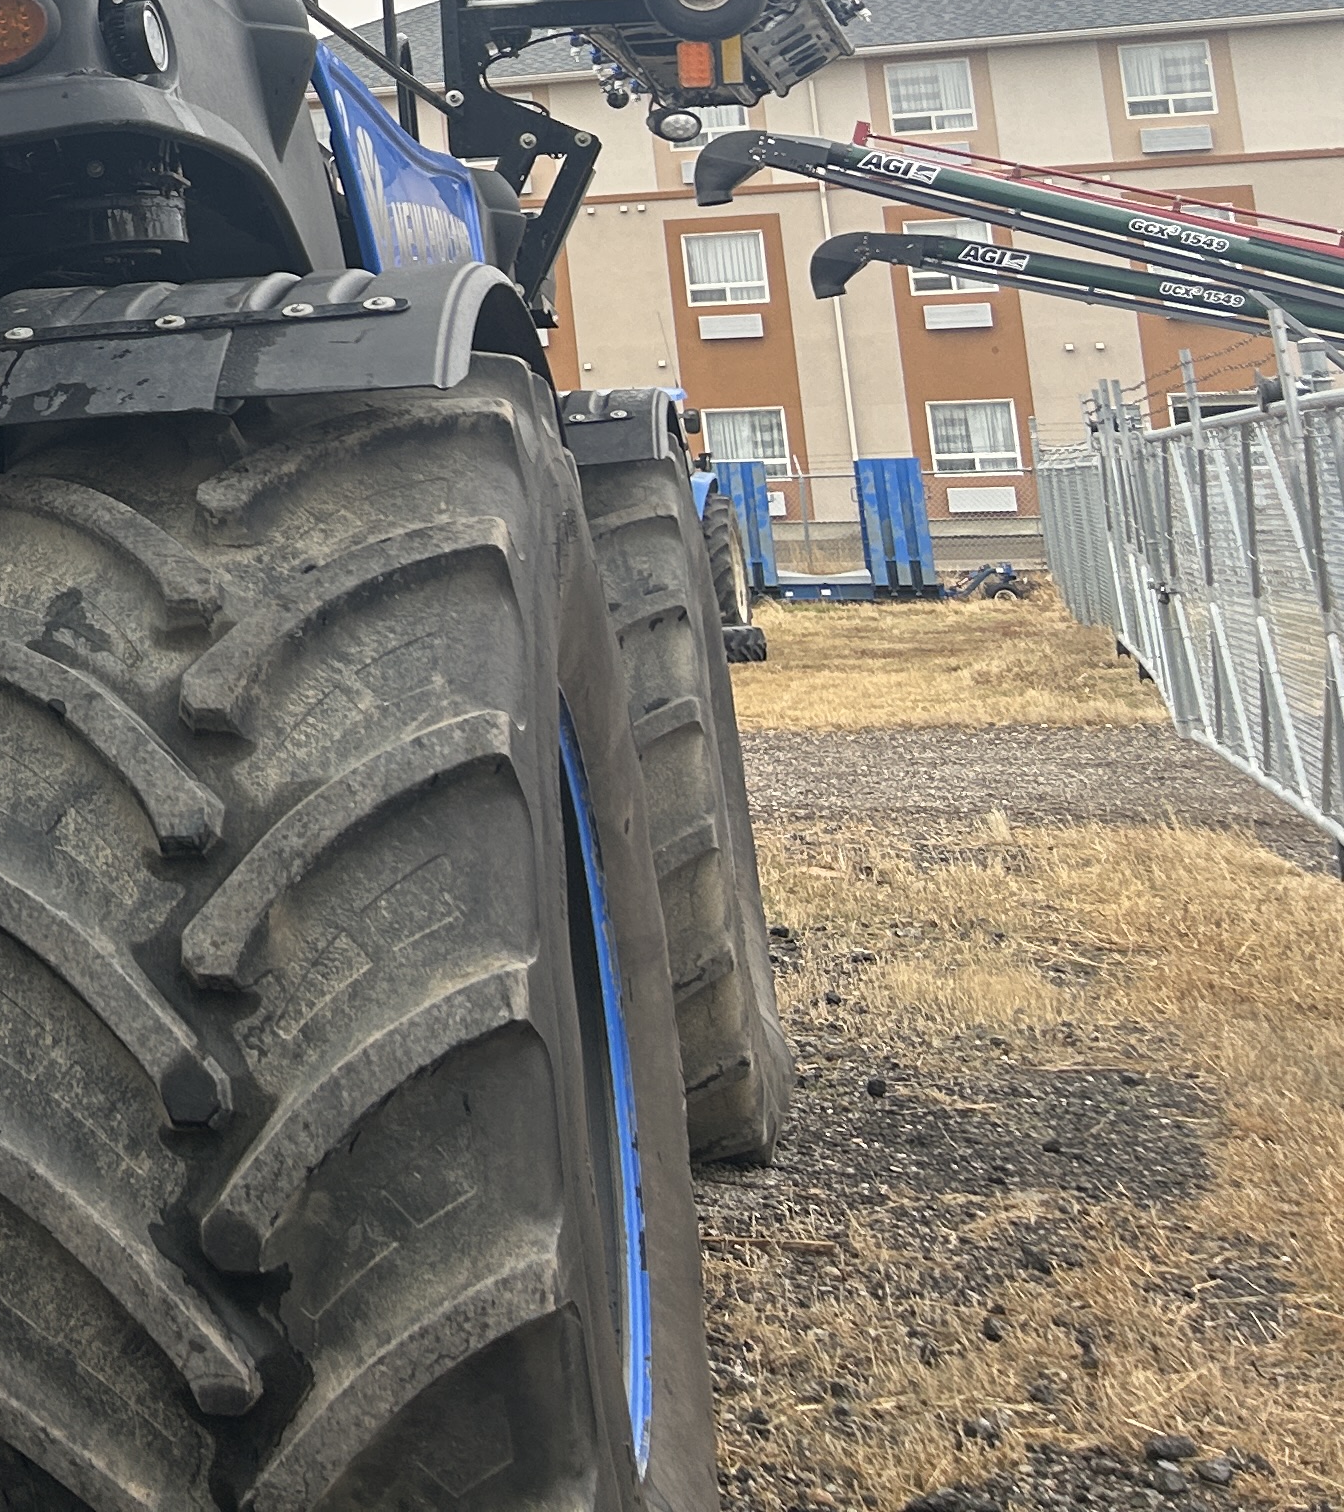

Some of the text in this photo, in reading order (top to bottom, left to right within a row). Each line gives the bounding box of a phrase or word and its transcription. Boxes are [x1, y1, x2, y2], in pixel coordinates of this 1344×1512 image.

[859, 153, 915, 178] AGI
[1180, 231, 1229, 252] 1549
[958, 245, 1008, 266] AGI
[1204, 290, 1245, 307] 1549
